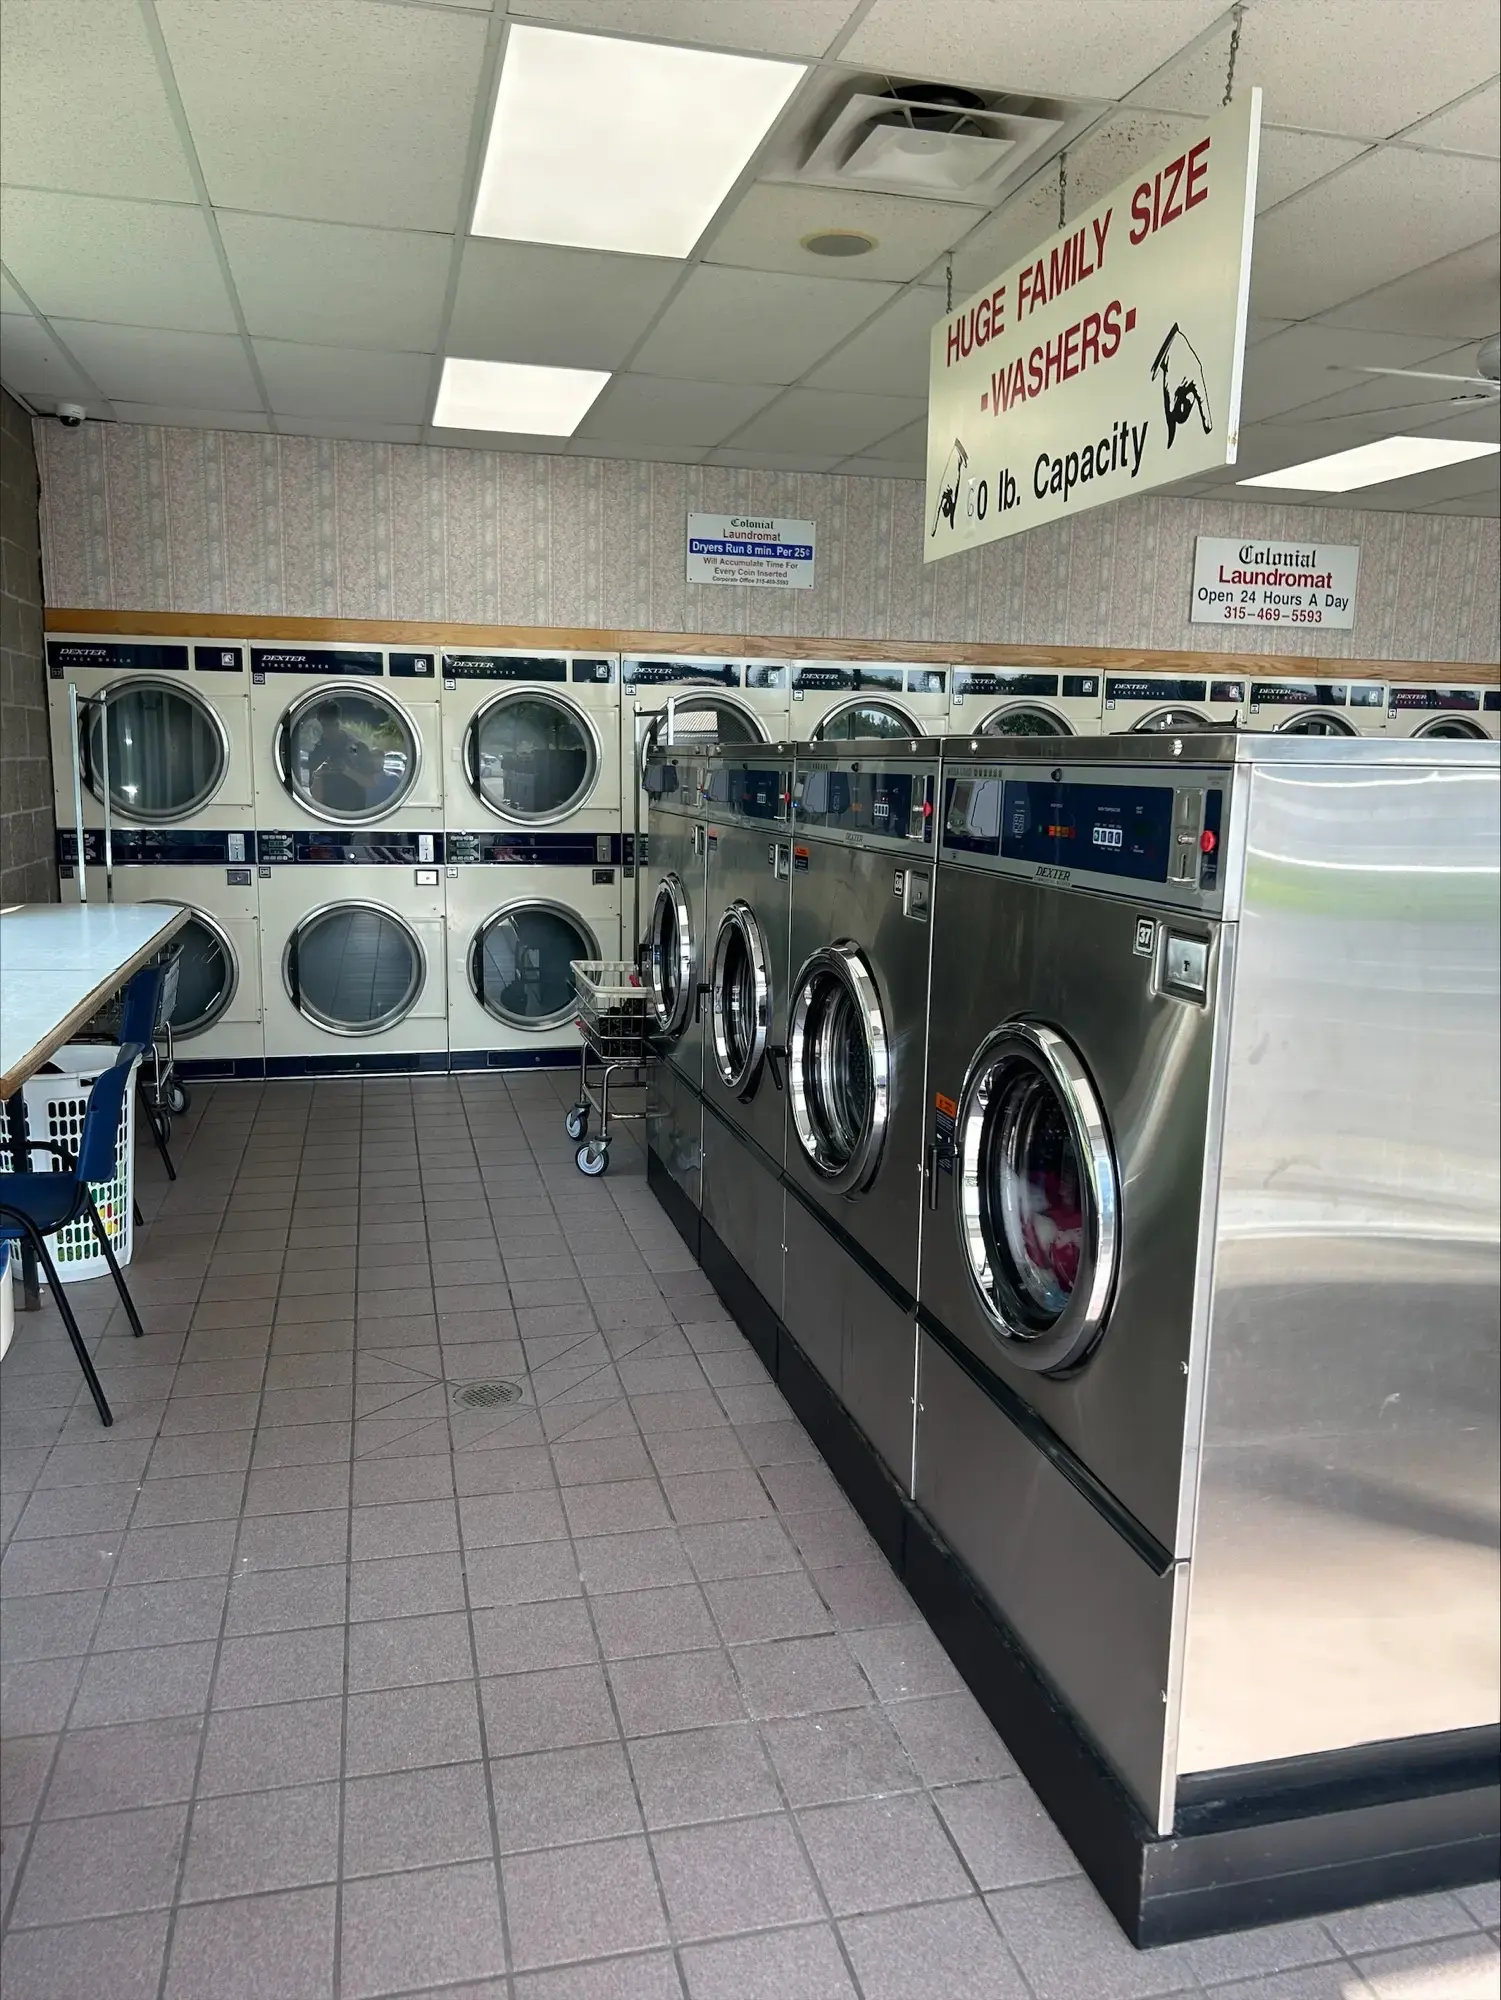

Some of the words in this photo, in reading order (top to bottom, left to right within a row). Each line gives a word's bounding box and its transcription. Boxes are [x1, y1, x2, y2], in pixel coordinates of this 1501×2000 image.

[946, 286, 1006, 367] HUGE
[1017, 208, 1113, 321] FAMILY
[1129, 136, 1211, 246] SIZE
[998, 470, 1020, 513] lb.
[1033, 420, 1148, 502] Capacity
[730, 518, 774, 530] Colonial
[723, 528, 781, 542] Laundromat
[692, 541, 723, 554] Dryers
[725, 542, 745, 554] Run
[746, 544, 753, 554] 8
[755, 545, 774, 556] min.
[777, 546, 792, 557] Per
[794, 547, 810, 558] 25¢
[1238, 544, 1317, 568] Colonial
[703, 556, 718, 565] Will
[720, 558, 764, 568] Accumulate
[766, 560, 784, 569] Time
[786, 561, 798, 569] For
[714, 567, 736, 576] Every
[738, 568, 754, 577] Coin
[756, 569, 788, 578] Inserted
[1218, 565, 1333, 589] Laundromat
[1197, 587, 1234, 605] Open
[1240, 590, 1256, 603] 24
[1263, 591, 1302, 606] Hours
[1308, 593, 1318, 606] A
[1325, 594, 1349, 611] Day
[1224, 606, 1323, 623] 315-469-5593
[60, 648, 107, 656] DEXTER
[1035, 866, 1070, 881] DEXTER
[1139, 926, 1151, 944] 37
